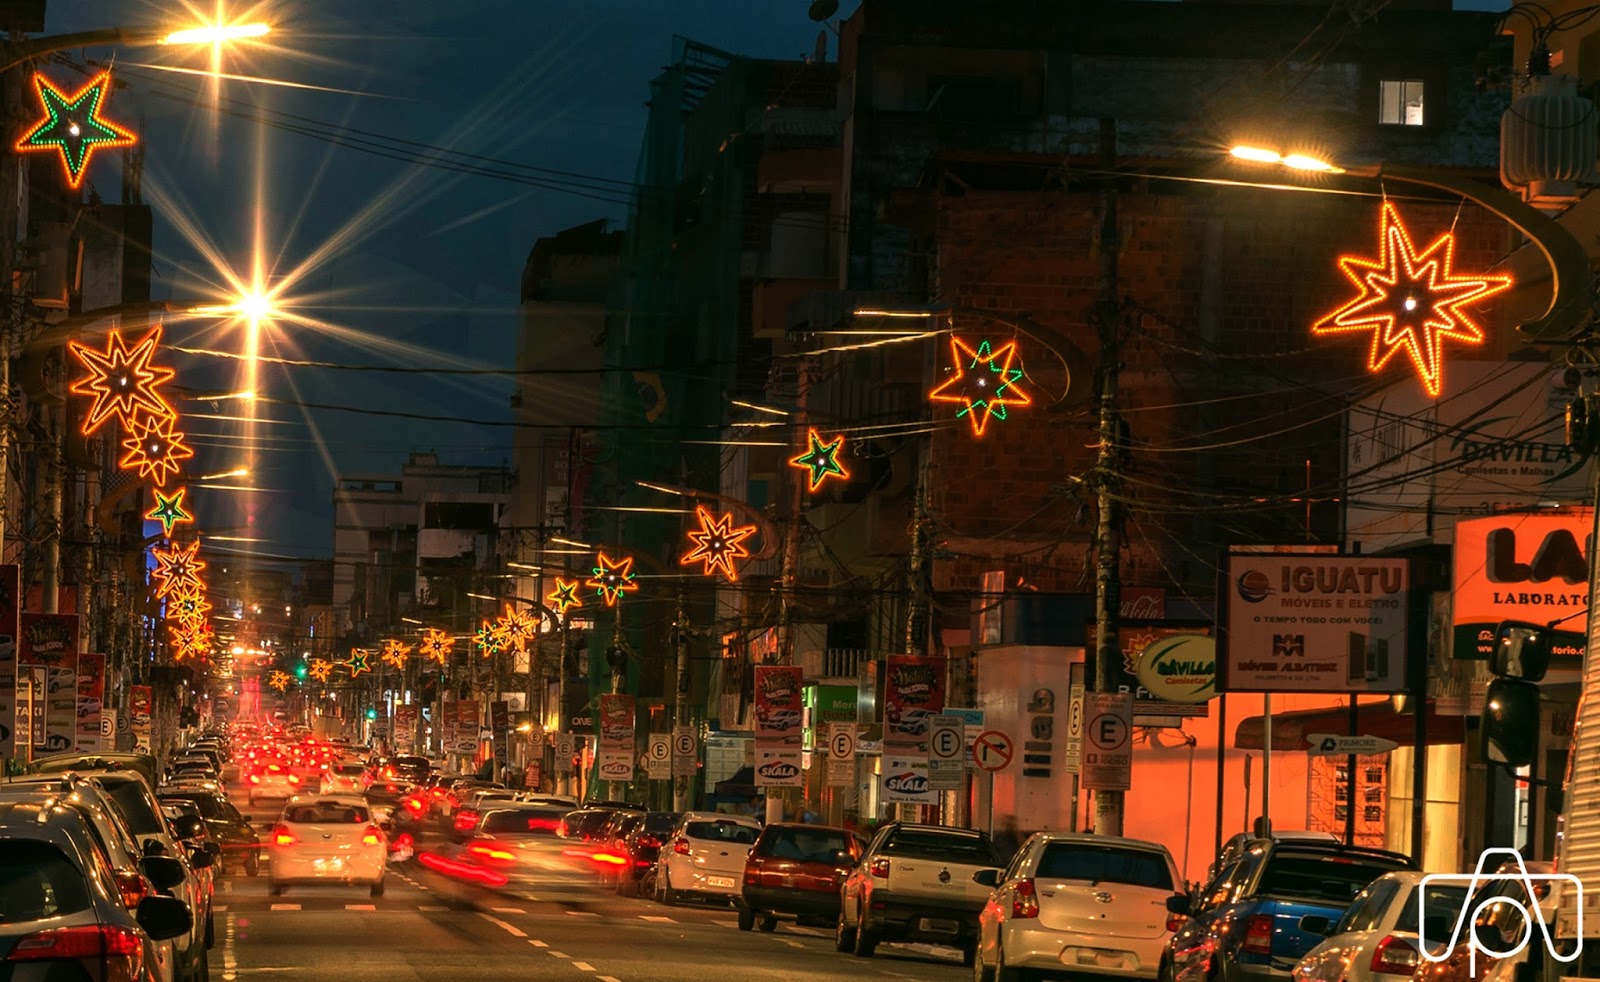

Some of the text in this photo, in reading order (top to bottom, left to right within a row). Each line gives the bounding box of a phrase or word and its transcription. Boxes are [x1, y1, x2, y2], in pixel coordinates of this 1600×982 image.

[1457, 464, 1555, 476] Camisetas e Malhas
[1485, 527, 1592, 585] LA
[1281, 565, 1402, 595] IGUATU
[1281, 597, 1400, 609] MÓVEIS E ELETRO
[1264, 616, 1297, 624] TEMPO
[1329, 617, 1351, 625] COM
[1281, 662, 1338, 673] ALBATROZ
[1165, 677, 1207, 685] Camisetas
[102, 721, 109, 733] E
[571, 717, 593, 726] ONE
[1100, 720, 1116, 743] E
[561, 743, 569, 753] E
[681, 738, 689, 750] E
[838, 738, 846, 753] E
[942, 734, 951, 751] E
[657, 745, 663, 756] E
[603, 765, 628, 773] SKALA
[761, 767, 796, 777] SKALA
[888, 778, 928, 791] SKALA
